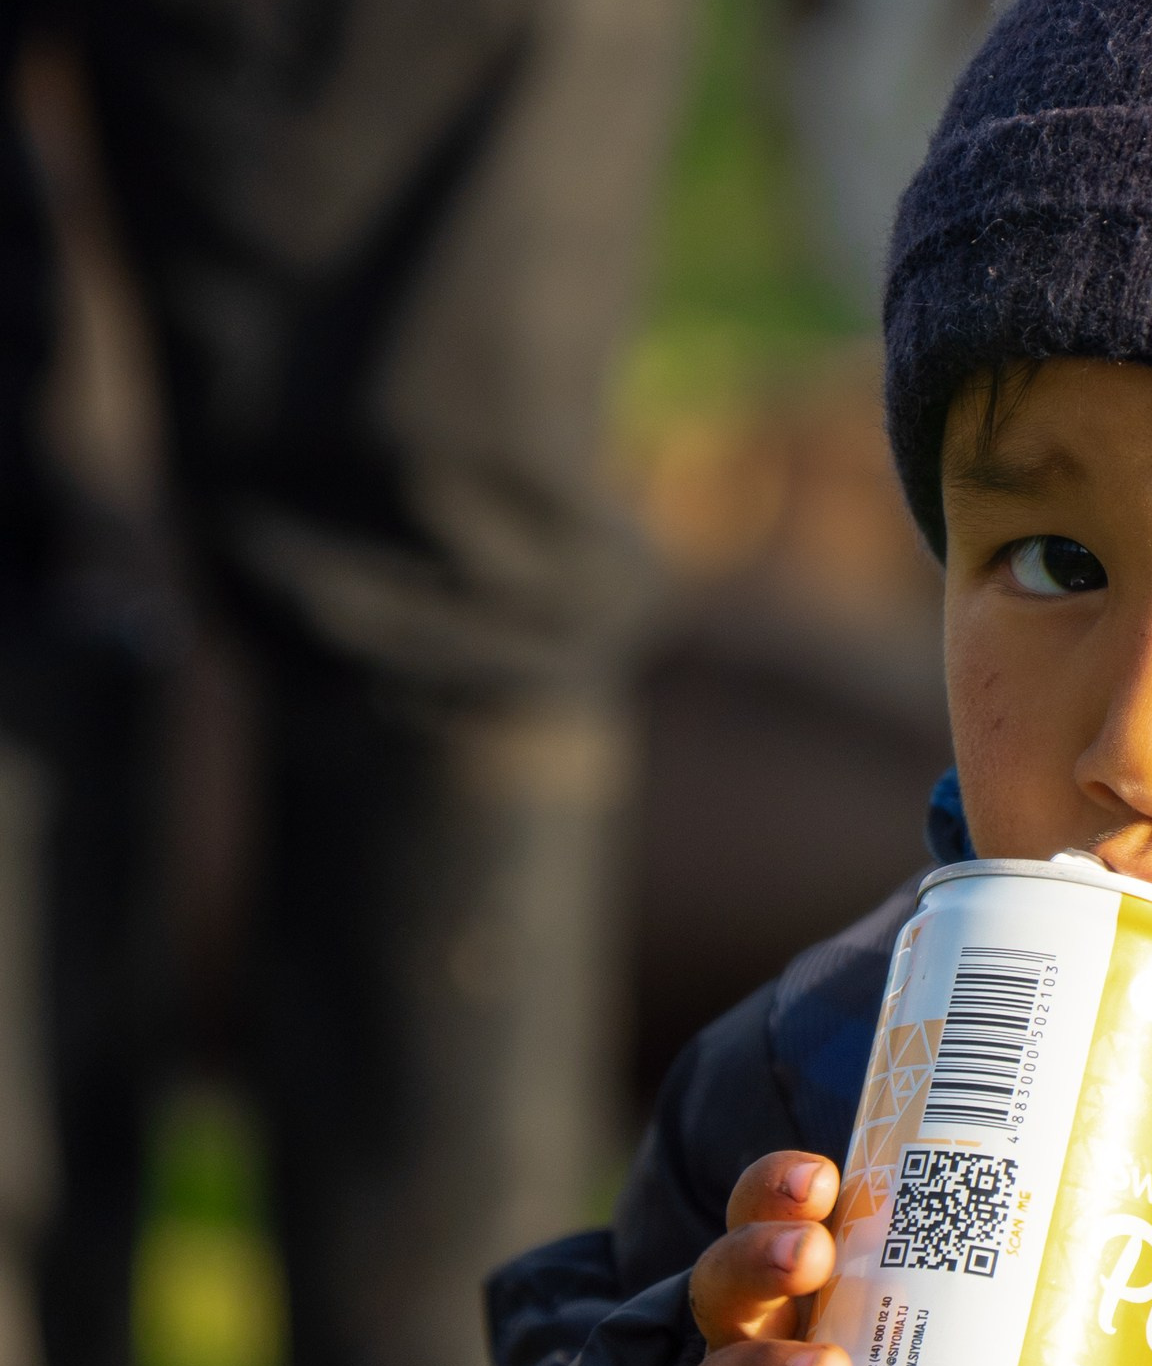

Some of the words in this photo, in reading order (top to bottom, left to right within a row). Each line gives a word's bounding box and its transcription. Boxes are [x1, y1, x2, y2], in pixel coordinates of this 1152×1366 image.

[1011, 1050, 1039, 1124] 883000
[1030, 965, 1058, 1038] 502103
[1005, 1218, 1024, 1258] SCAN
[1016, 1190, 1031, 1212] ME
[881, 1296, 892, 1309] 40
[878, 1310, 888, 1323] 02
[873, 1324, 885, 1342] 600
[869, 1344, 882, 1363] (44)
